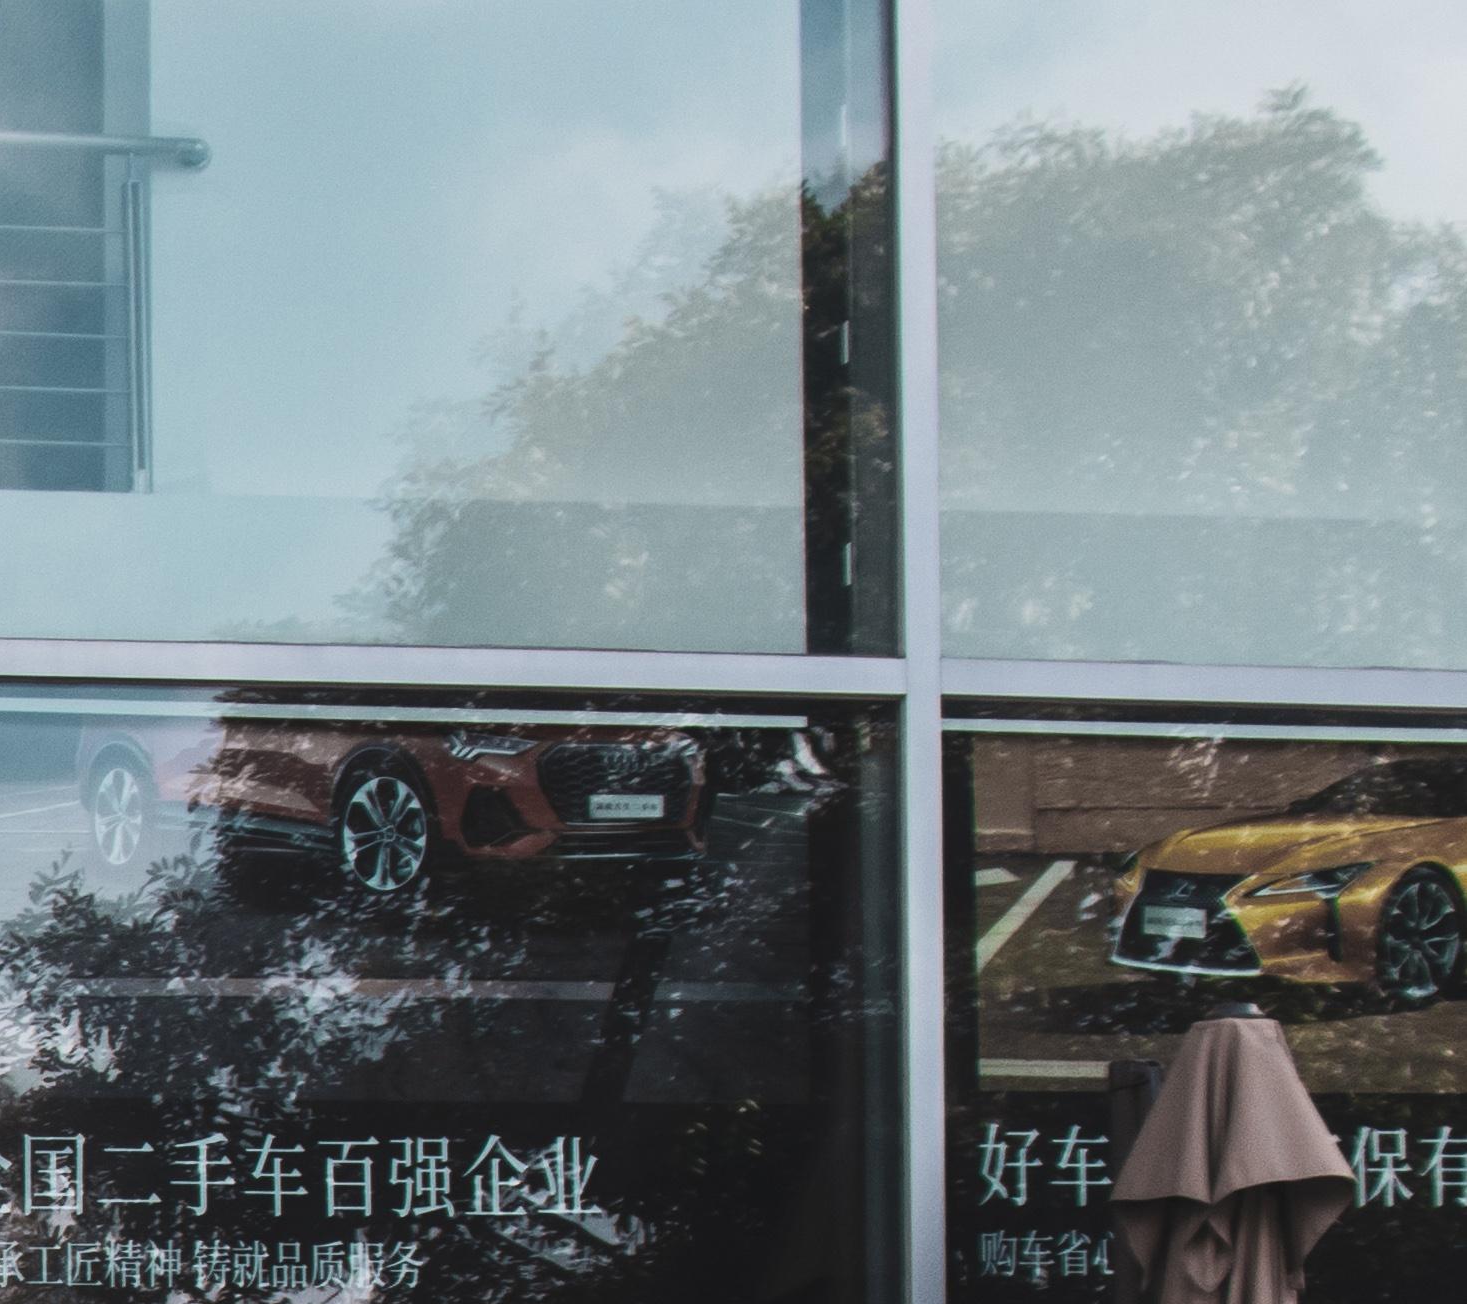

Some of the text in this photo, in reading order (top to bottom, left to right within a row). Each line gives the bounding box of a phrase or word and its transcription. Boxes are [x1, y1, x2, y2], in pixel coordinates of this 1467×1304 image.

[193, 1240, 426, 1290] 铸就品质服务
